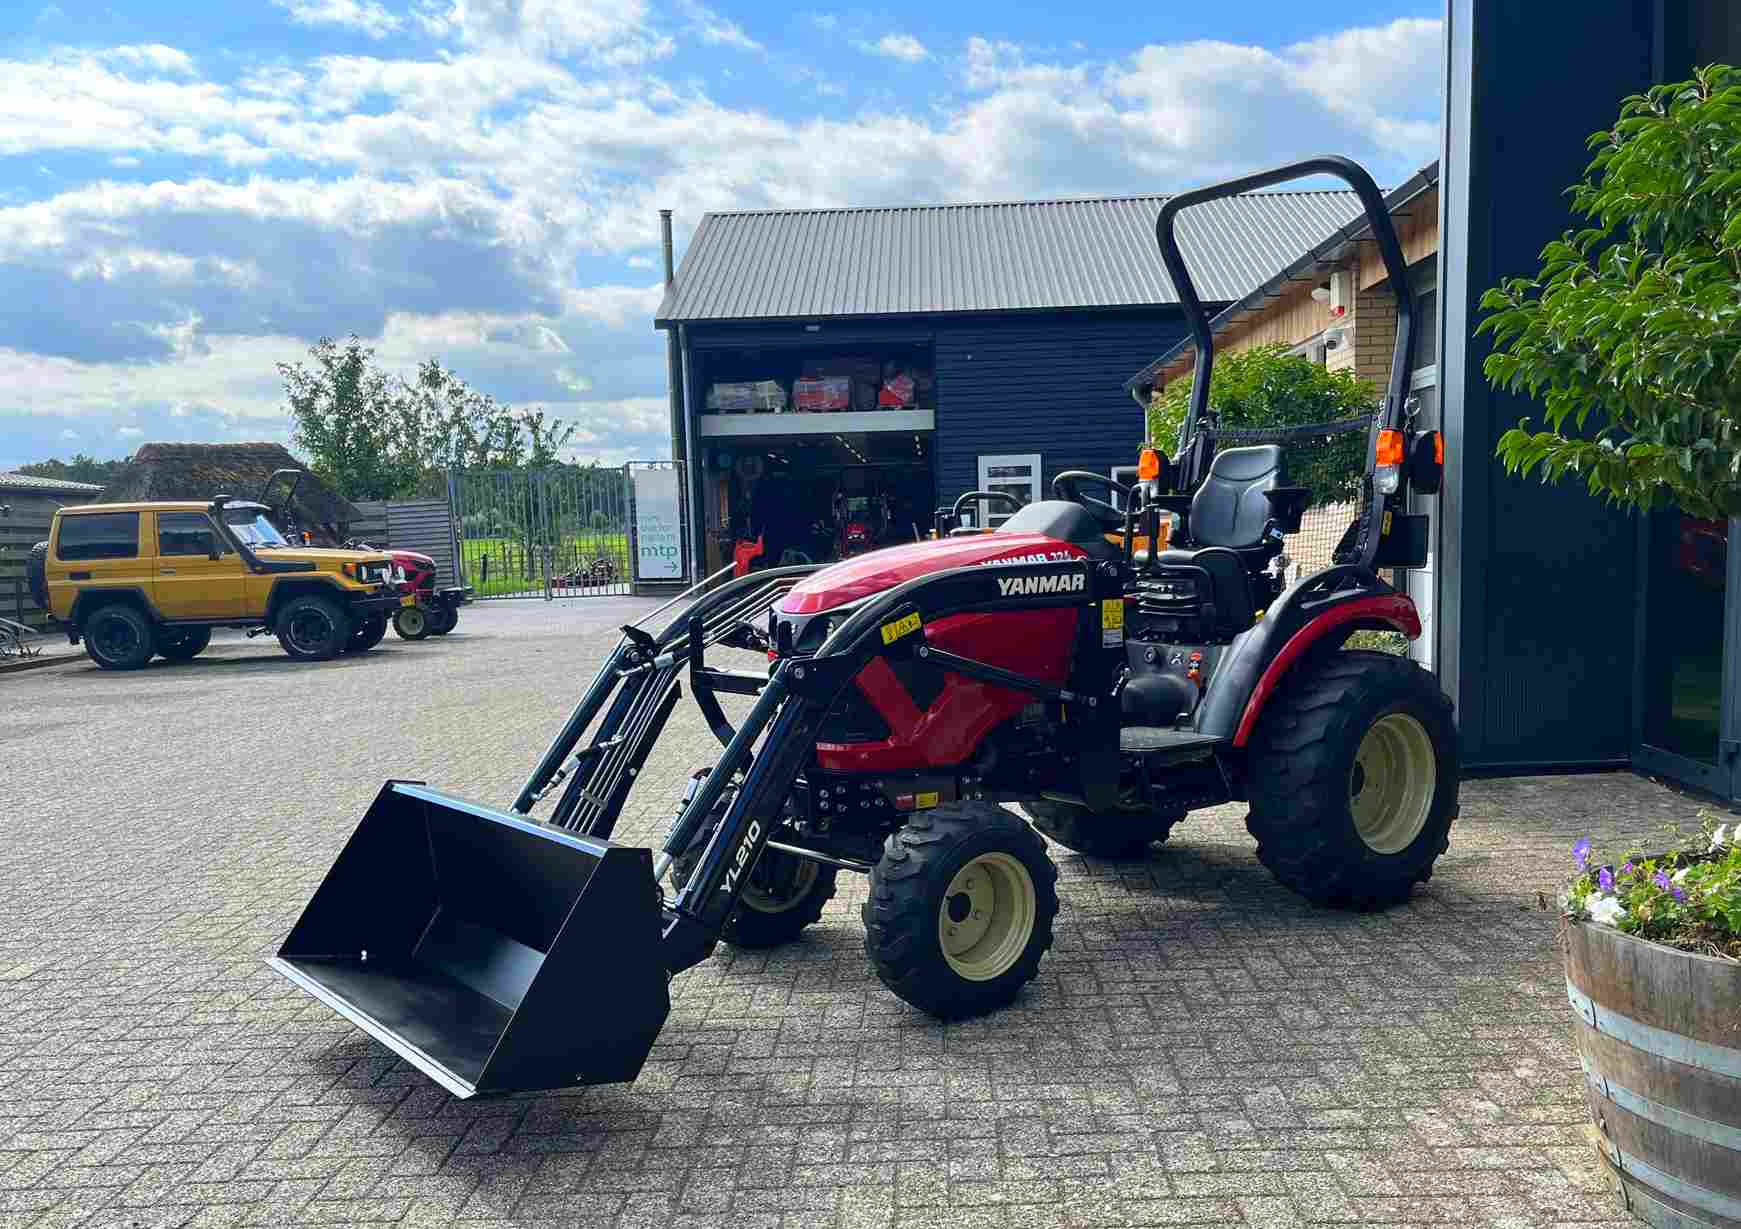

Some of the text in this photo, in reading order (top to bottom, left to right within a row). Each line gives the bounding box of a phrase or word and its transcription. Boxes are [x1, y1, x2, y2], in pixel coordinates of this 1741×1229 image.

[640, 546, 678, 560] mtp
[997, 574, 1085, 596] YANMAR
[719, 820, 761, 893] YL210
